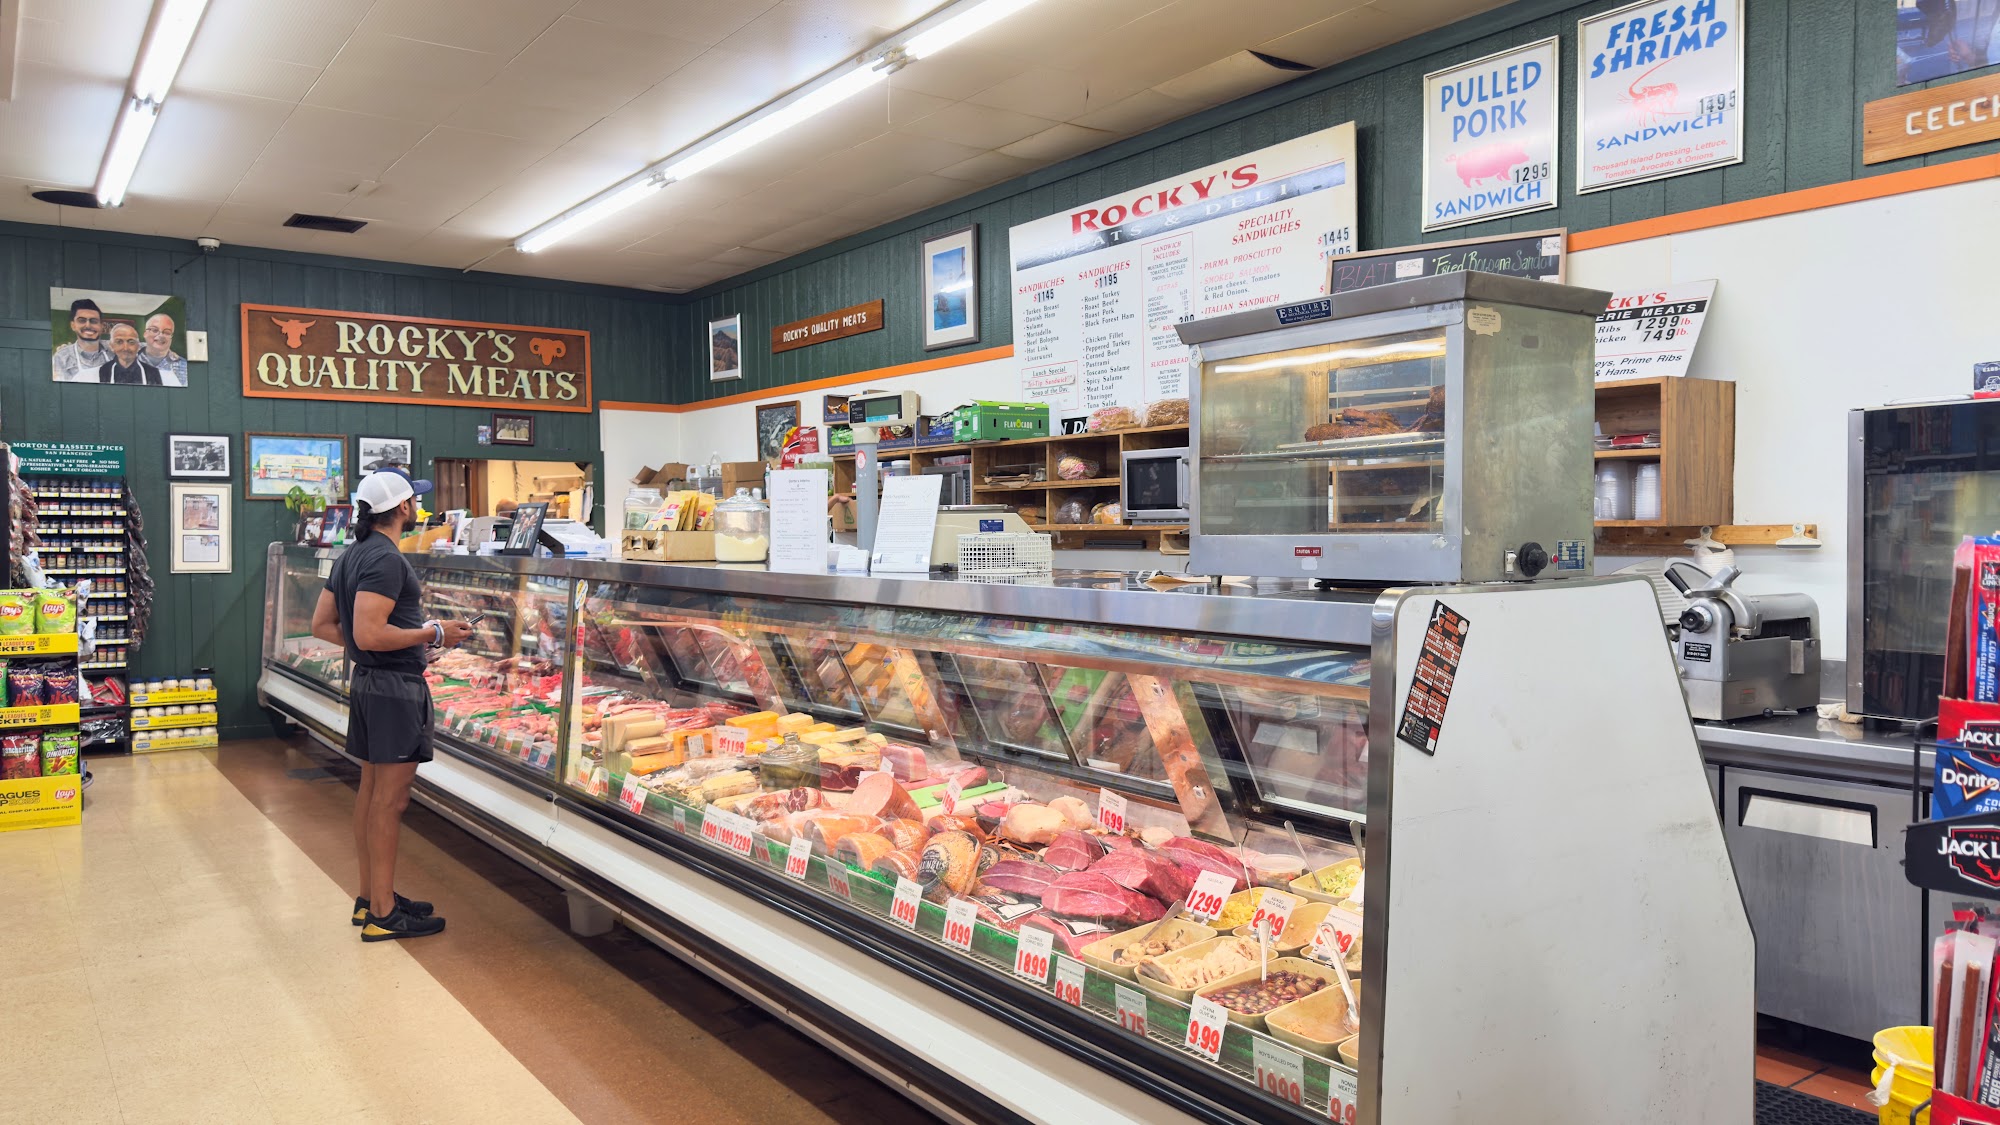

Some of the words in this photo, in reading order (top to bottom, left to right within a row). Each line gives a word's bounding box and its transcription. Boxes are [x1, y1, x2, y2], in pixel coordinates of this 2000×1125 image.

[1606, 0, 1716, 49] FRESH
[1591, 20, 1728, 79] SHRIMP
[1441, 61, 1541, 112] PULLED
[1453, 98, 1527, 142] PORK
[1596, 112, 1723, 151] SANDWICH
[1592, 158, 1629, 172] Thousand
[1630, 153, 1654, 166] Island
[1656, 146, 1692, 160] Dressing,
[1695, 139, 1728, 151] Lettuce,
[1640, 160, 1674, 172] Avocado
[1685, 151, 1714, 163] Onions
[1515, 162, 1548, 183] 1295
[1070, 163, 1259, 235] ROCKY'S
[1205, 184, 1288, 216] DELI
[1435, 181, 1541, 219] SANDWICH
[1238, 208, 1294, 231] SPECIALTY
[1231, 219, 1301, 245] SANDWICHES
[1153, 240, 1182, 254] SANDWICH
[1204, 258, 1229, 270] PARMA
[1233, 246, 1282, 263] PROSCIUTTO
[1078, 259, 1131, 281] SANDWICHES
[1204, 271, 1234, 285] SMOKED
[1018, 276, 1065, 295] SANDWICHES
[1204, 284, 1223, 293] Cream
[1252, 271, 1281, 283] Tomatoes
[1084, 295, 1099, 303] Roast
[1102, 290, 1120, 299] Turkey
[1204, 302, 1234, 315] ITALIAN
[1238, 293, 1280, 309] SANDWICH
[1212, 290, 1224, 300] Red
[1026, 308, 1041, 316] Turkey
[1043, 303, 1060, 311] Breast
[1084, 303, 1099, 311] Roast
[1085, 311, 1100, 319] Roast
[1102, 308, 1115, 316] Pork
[1279, 300, 1330, 319] ESQUIRE
[1640, 303, 1697, 317] MEATS
[1026, 314, 1042, 323] Danish
[1044, 311, 1056, 319] Ham
[1026, 322, 1044, 331] Salame
[1085, 319, 1099, 328] Black
[1102, 316, 1119, 324] Forest
[1121, 312, 1135, 320] Ham
[1597, 325, 1621, 334] Ribs
[1636, 315, 1680, 331] 1299
[1680, 317, 1692, 326] lb.
[783, 326, 809, 342] ROCKY'S
[811, 318, 839, 335] QUALITY
[842, 312, 867, 327] MEATS
[1026, 329, 1051, 338] Mortadella
[1643, 328, 1676, 342] 749
[336, 320, 517, 363] ROCKY'S
[1026, 338, 1038, 346] Beef
[1039, 335, 1059, 344] Bologna
[1085, 335, 1106, 344] Chicken
[1108, 332, 1124, 340] Fillet
[1085, 343, 1109, 353] Peppered
[1112, 339, 1131, 349] Turkey
[1026, 346, 1036, 354] Hot
[1037, 344, 1048, 352] Link
[1085, 352, 1105, 360] Corned
[1107, 348, 1120, 357] Beef
[1086, 360, 1110, 368] Pastrami
[1151, 359, 1169, 368] SLICED
[1170, 356, 1188, 365] BREAD
[1620, 357, 1652, 365] Prime
[1656, 354, 1683, 363] Ribs
[257, 351, 432, 393] QUALITY
[446, 363, 578, 400] MEATS
[1032, 369, 1047, 377] Lunch
[1048, 365, 1066, 375] Special
[1086, 368, 1107, 377] Toscano
[1110, 365, 1130, 373] Salame
[1086, 377, 1101, 386] Spicy
[1103, 374, 1123, 382] Salame
[1605, 368, 1638, 376] Hams.
[1031, 389, 1043, 397] Soup
[1101, 383, 1114, 391] Loaf
[1102, 399, 1117, 407] Salad
[1979, 652, 1987, 679] CHICKEN
[1978, 680, 1986, 700] STICK
[1987, 666, 1996, 698] RANCH
[1956, 727, 1994, 746] JACK
[1942, 767, 2000, 790] Dorito
[1938, 836, 1991, 859] JACK
[1189, 1020, 1220, 1054] 9.99
